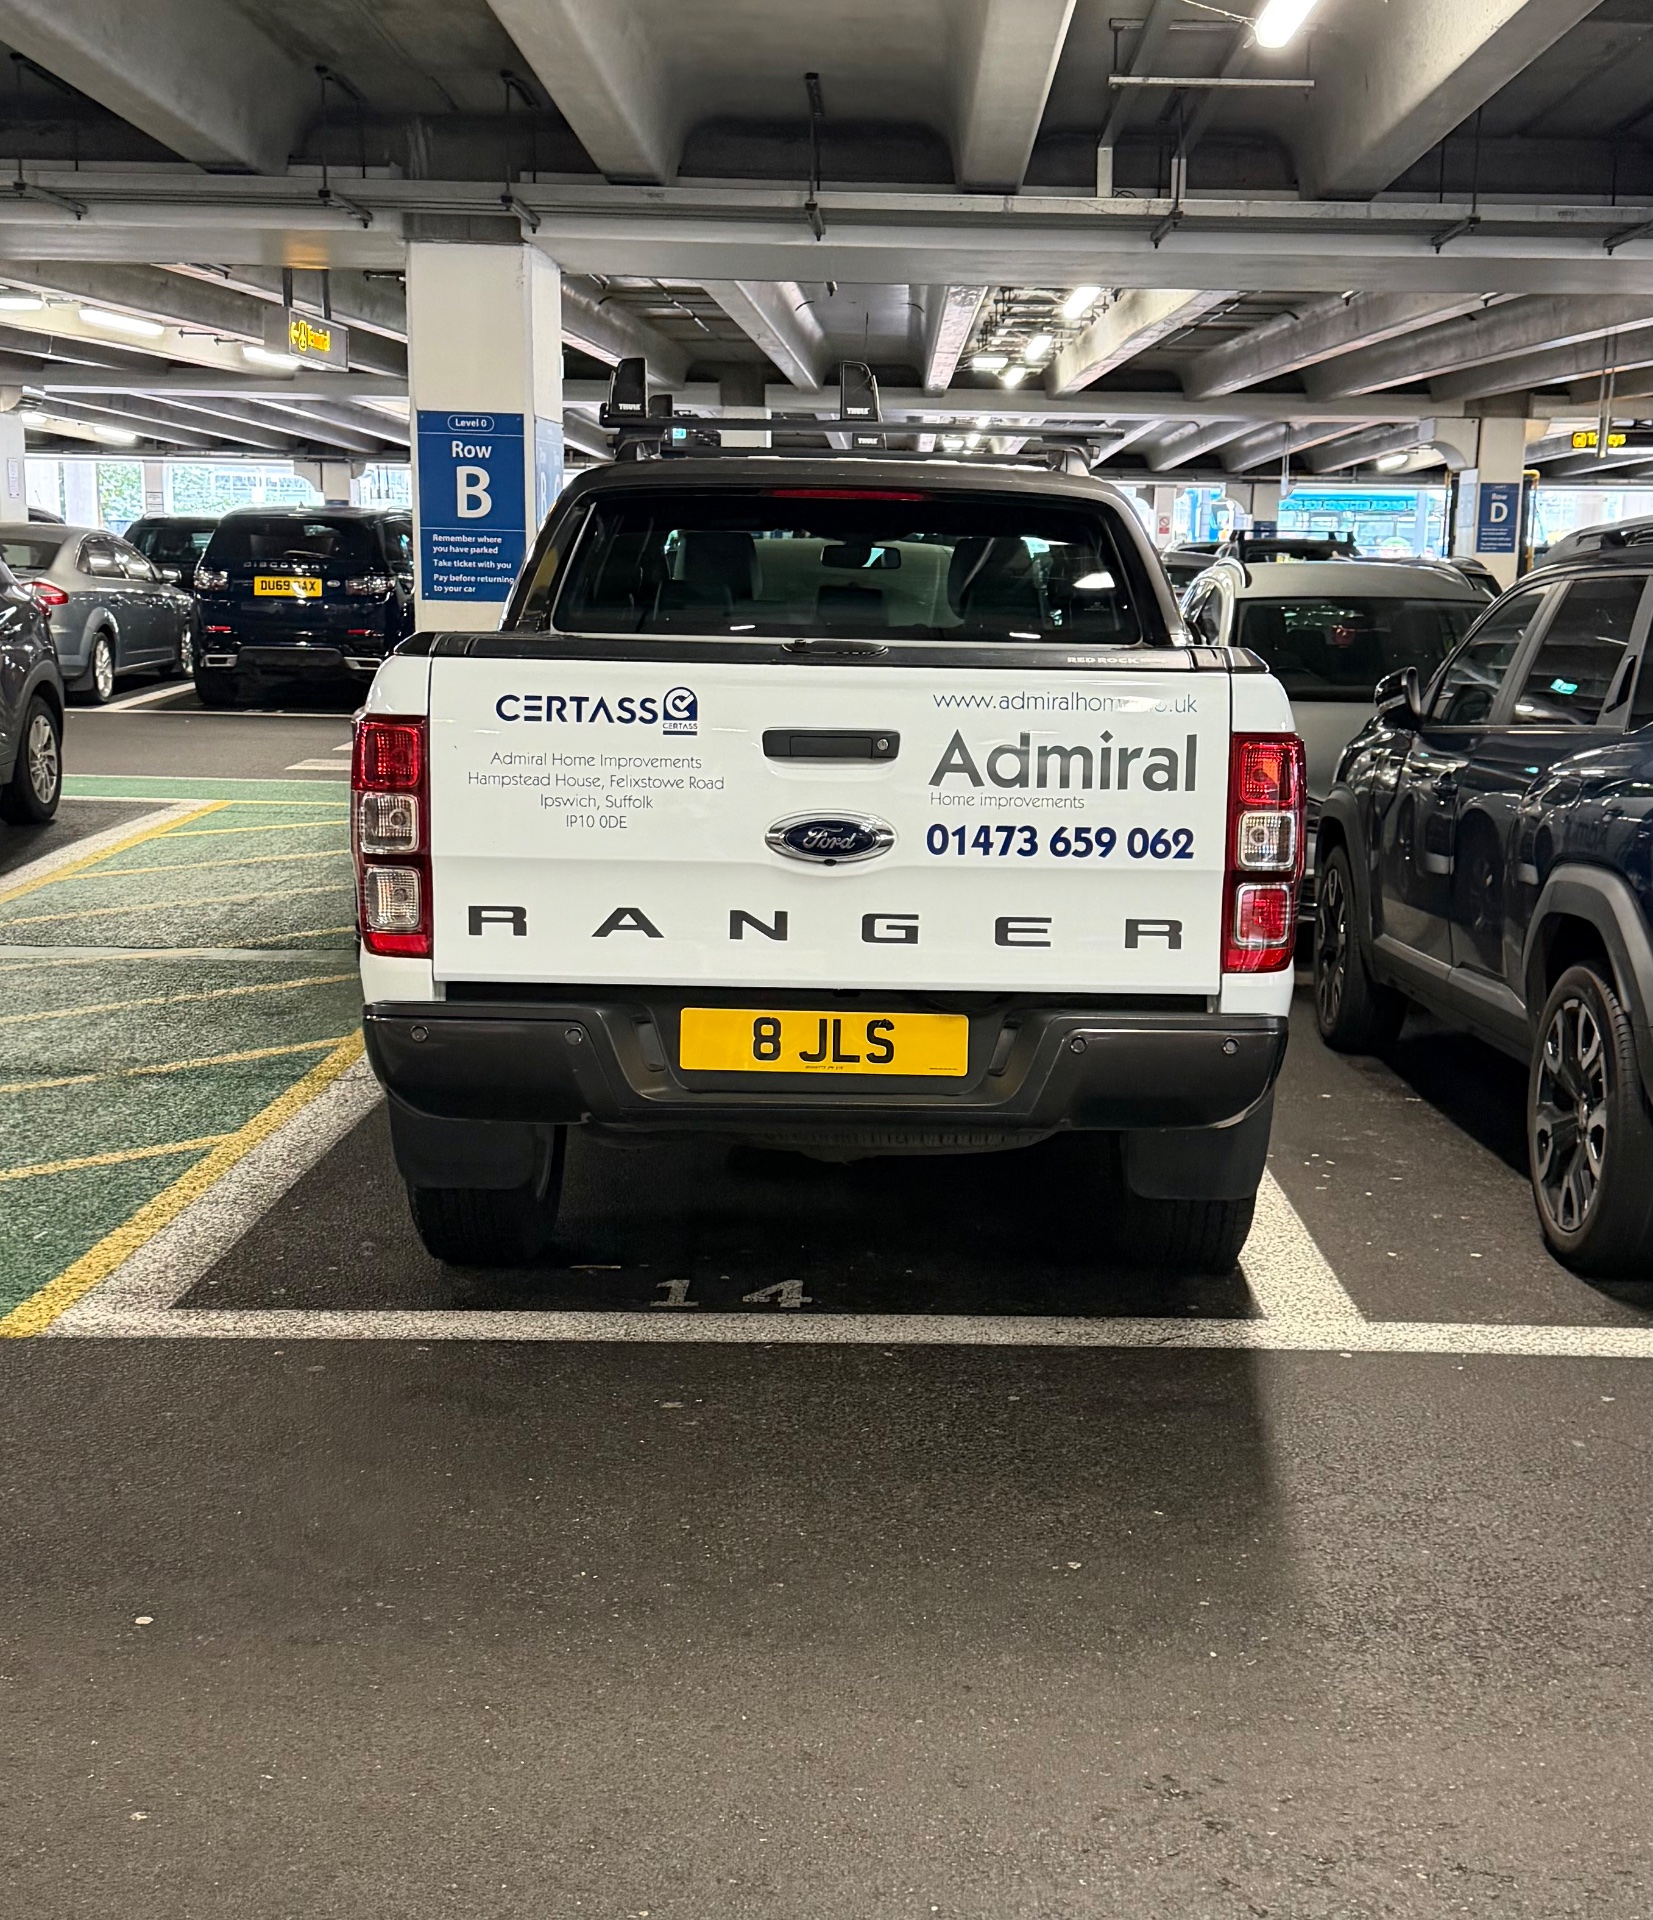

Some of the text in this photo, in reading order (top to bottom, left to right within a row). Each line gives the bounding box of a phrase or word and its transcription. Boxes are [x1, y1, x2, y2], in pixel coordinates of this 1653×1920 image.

[455, 418, 487, 428] Level 0
[452, 441, 491, 458] Row
[457, 466, 491, 518] B
[1491, 502, 1507, 522] D
[432, 533, 503, 544] Remember where
[432, 544, 499, 555] you have parked
[433, 558, 512, 570] Take ticket with you
[260, 578, 291, 592] DU69
[433, 573, 514, 585] Pay before returning
[433, 584, 443, 592] to
[444, 586, 463, 594] your
[1097, 656, 1140, 664] ROCK
[496, 695, 658, 724] CERTASS
[663, 723, 698, 731] CERTASS
[490, 752, 701, 770] Admiral Home Improvements
[928, 729, 1197, 792] Admiral
[469, 772, 724, 790] Hampstead House, Felixstowe Road
[541, 794, 653, 810] Ipswich, Suffolk
[931, 792, 1084, 810] Home improvements
[567, 815, 595, 828] IP10
[802, 824, 856, 850] Ford
[927, 824, 1194, 859] 01473 659 062
[468, 906, 1182, 949] RANGER
[753, 1017, 894, 1063] 8 JLS
